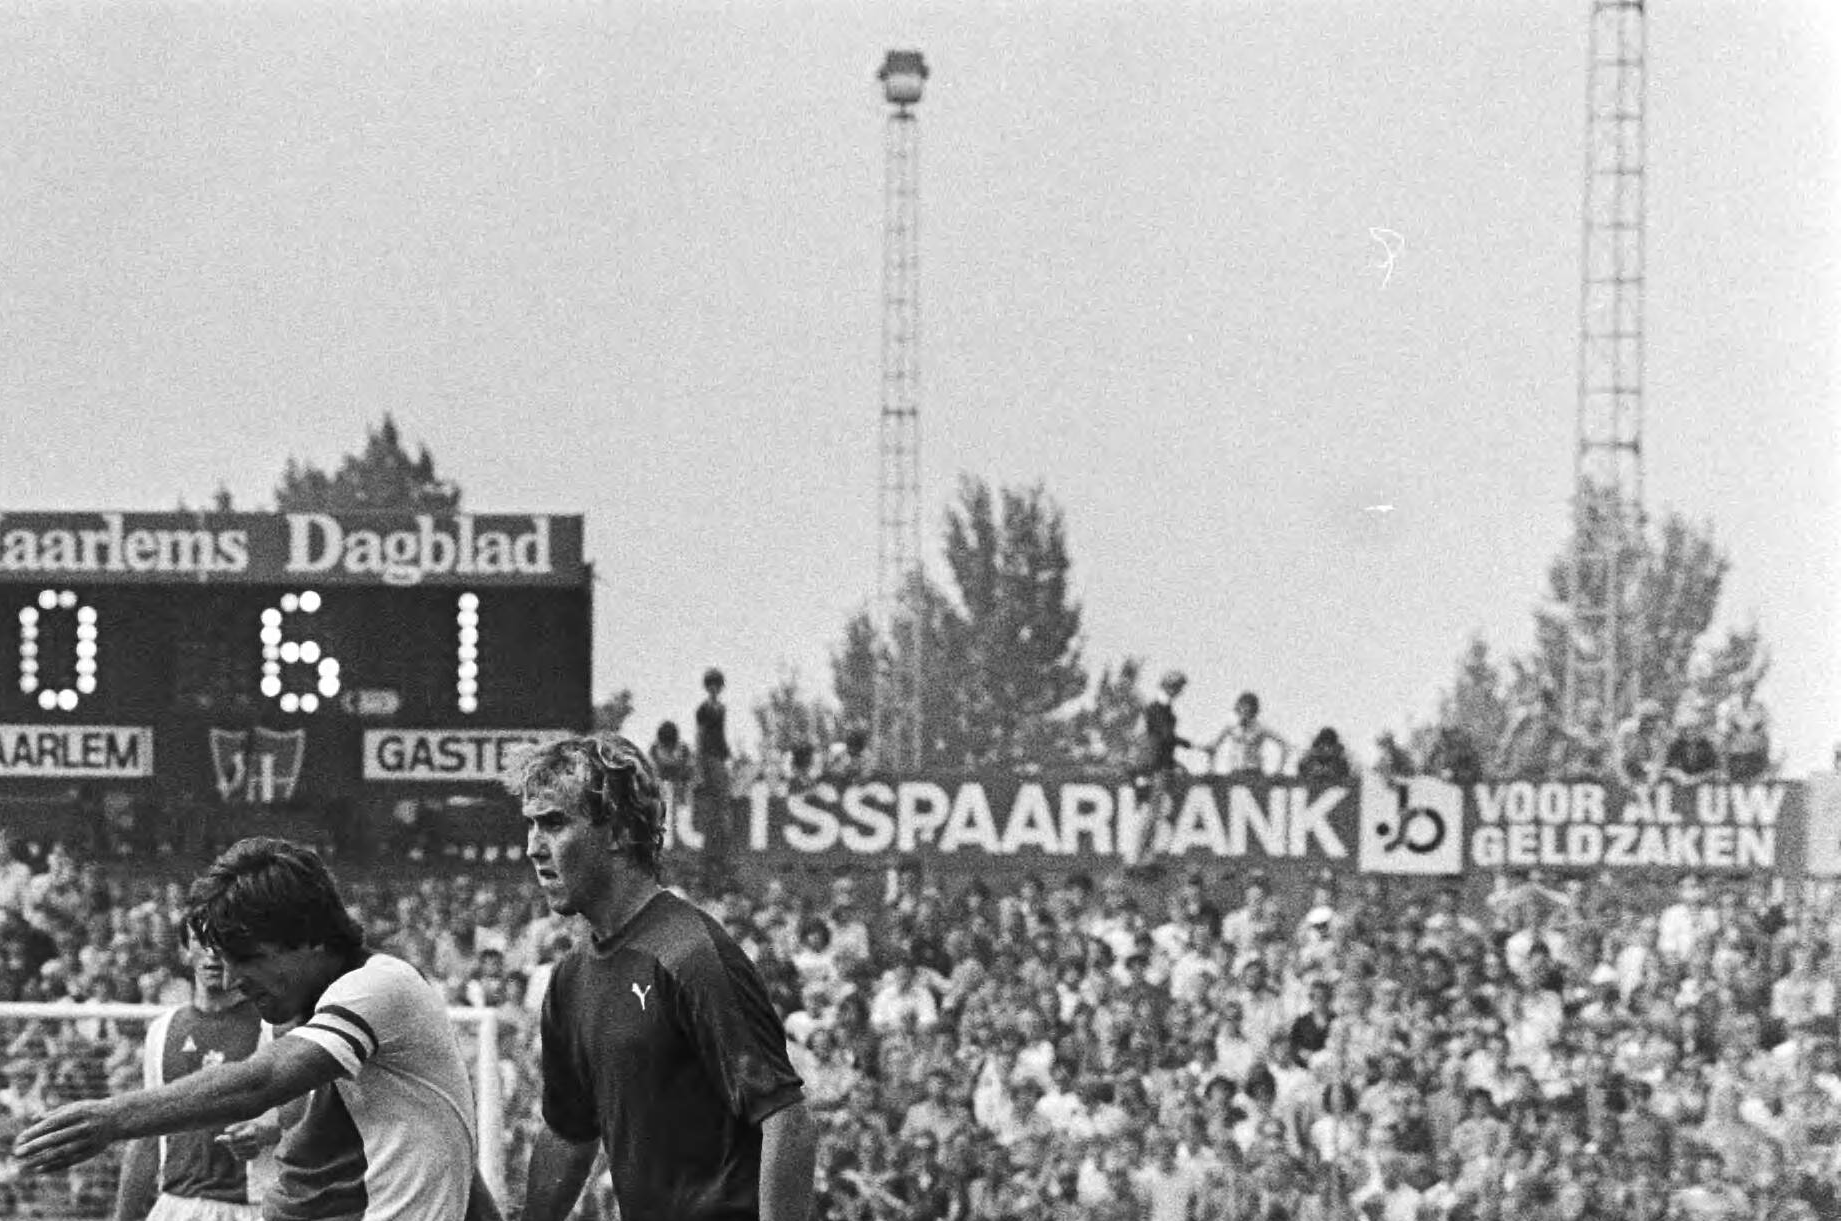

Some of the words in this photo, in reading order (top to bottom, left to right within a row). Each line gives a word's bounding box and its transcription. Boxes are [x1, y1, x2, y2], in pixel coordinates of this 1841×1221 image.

[286, 513, 553, 585] Dagblad
[20, 589, 98, 710] 0
[260, 590, 341, 712] 6
[458, 592, 479, 712] 1
[376, 736, 541, 773] GASTE
[1473, 781, 1606, 823] VOOR
[1696, 781, 1785, 824] UW
[1470, 825, 1776, 867] GELDZAKEN
